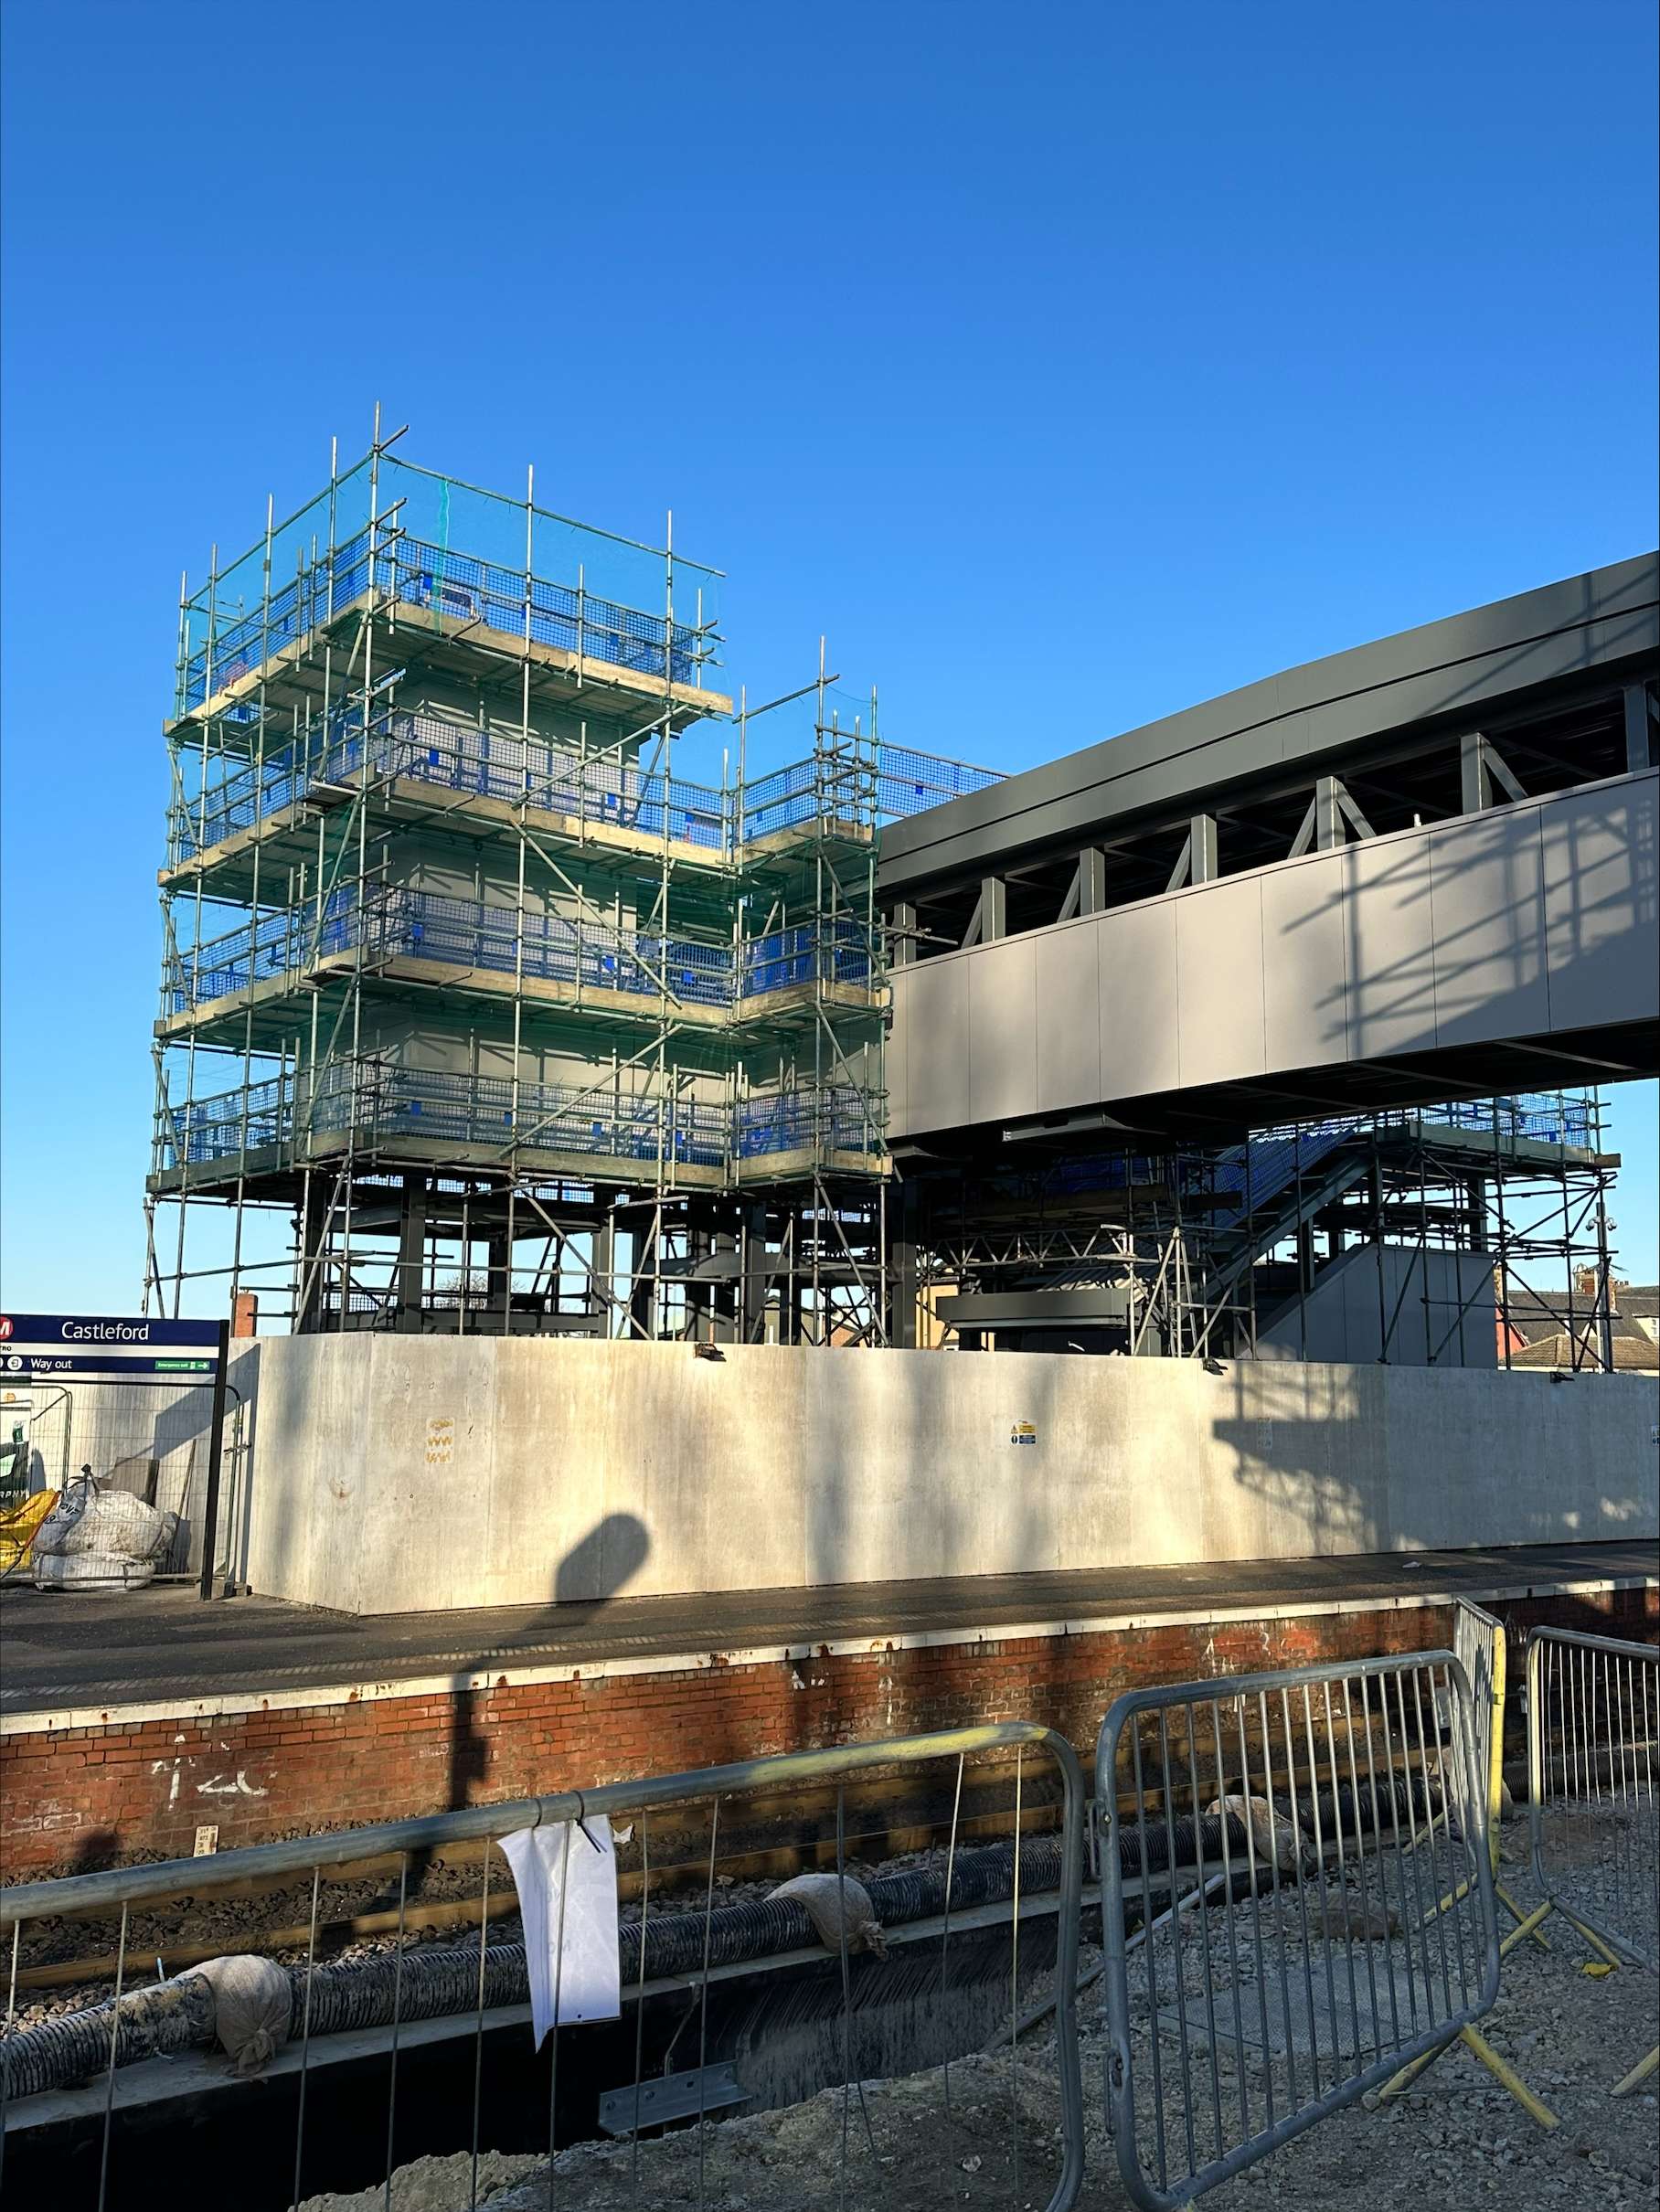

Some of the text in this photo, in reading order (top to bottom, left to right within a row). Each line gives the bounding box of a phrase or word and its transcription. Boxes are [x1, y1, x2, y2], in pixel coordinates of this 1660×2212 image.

[61, 1321, 150, 1341] Castleford
[30, 1357, 73, 1371] Way out
